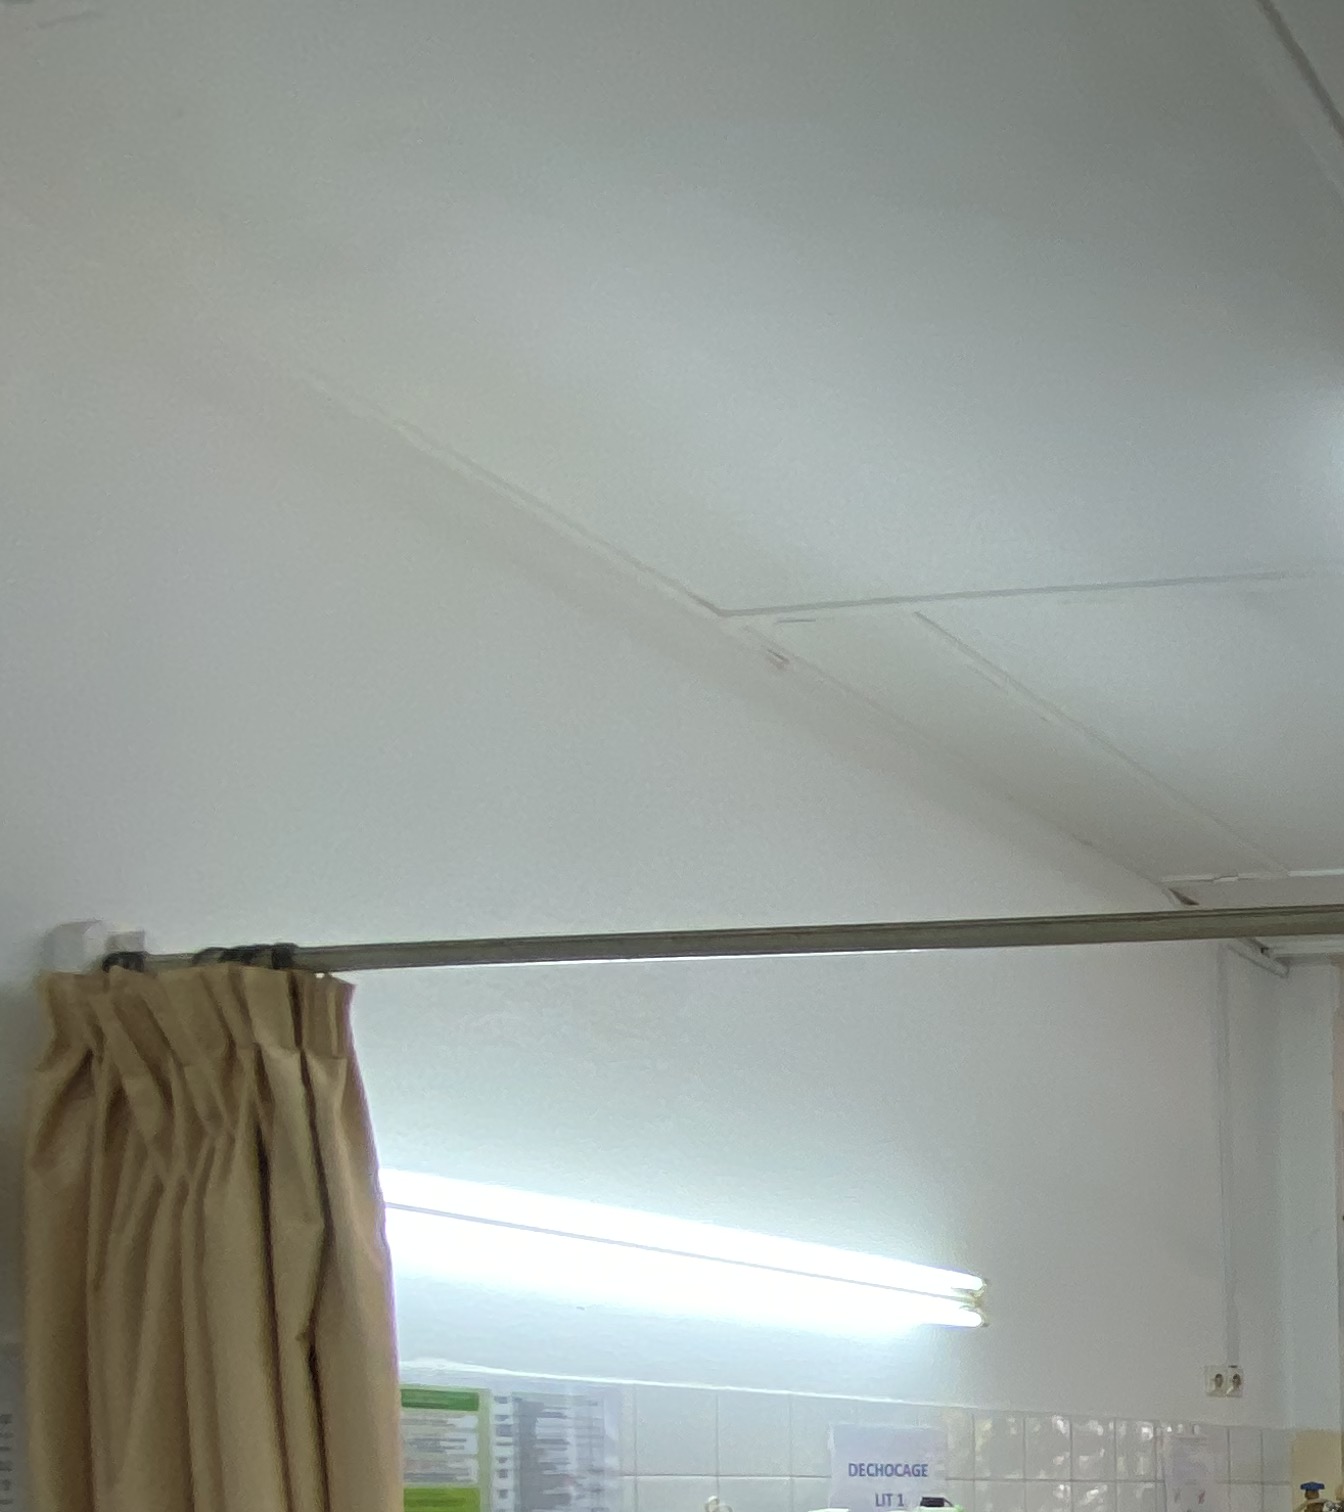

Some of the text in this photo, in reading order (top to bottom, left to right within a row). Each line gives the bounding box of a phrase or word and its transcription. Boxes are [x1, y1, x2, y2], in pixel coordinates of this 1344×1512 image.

[848, 1463, 928, 1477] DECHOCAGE
[875, 1493, 904, 1507] LIT 1
